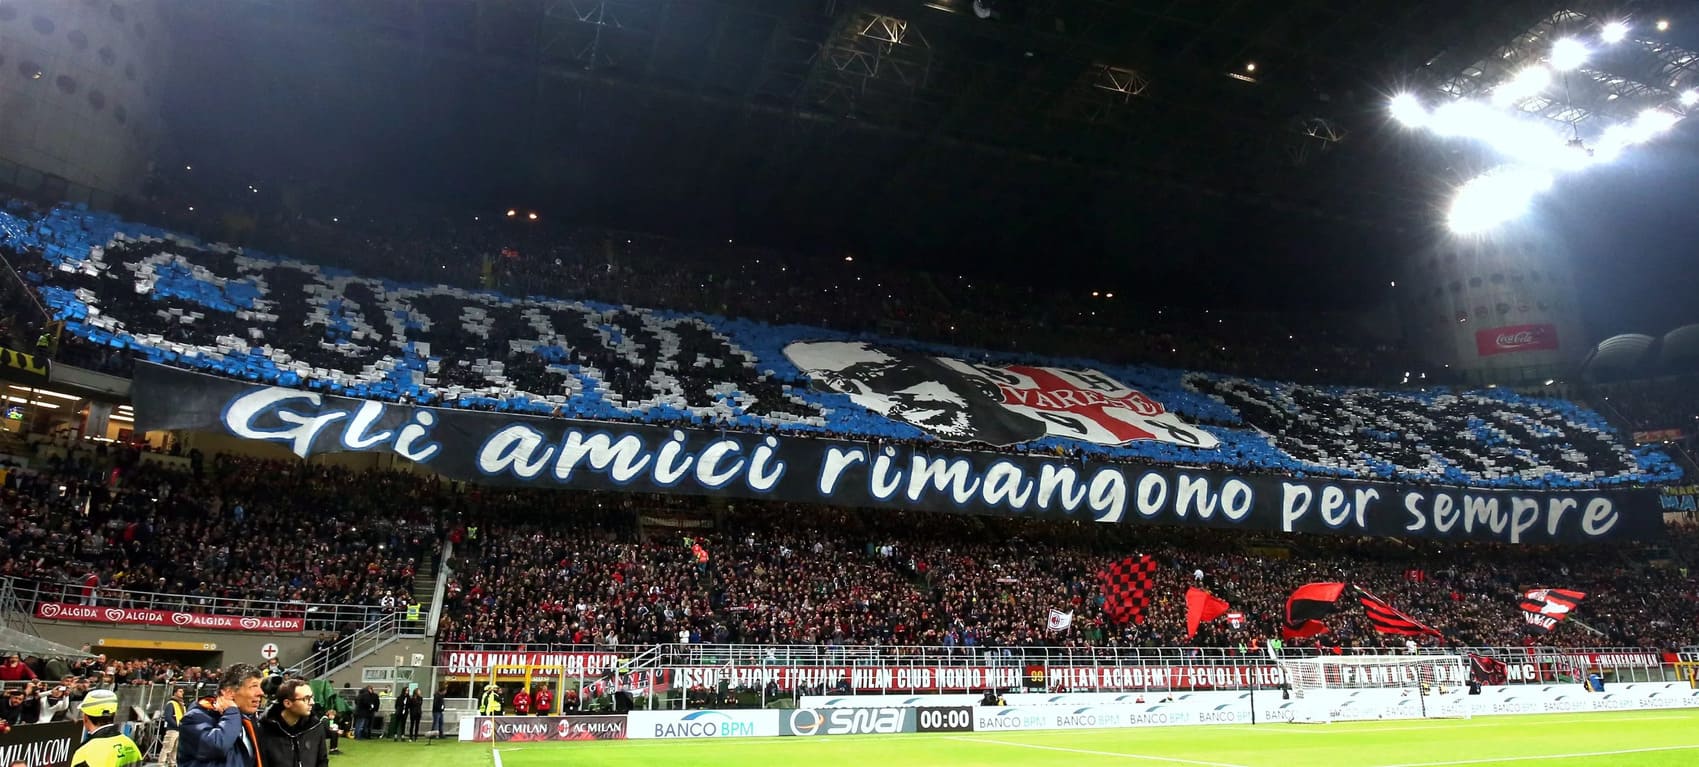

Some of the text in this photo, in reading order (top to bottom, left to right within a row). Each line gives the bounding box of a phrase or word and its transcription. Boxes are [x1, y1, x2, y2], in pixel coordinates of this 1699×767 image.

[224, 386, 1619, 544] Gli amici rimangono per sempre
[60, 607, 298, 629] ALGIDA ALGIDA ALGIDA ALGIDA
[449, 652, 483, 674] CASA
[487, 653, 527, 675] MILAN
[539, 654, 585, 675] JUNIOR
[851, 668, 893, 688] MILAN
[897, 668, 931, 688] CLUB
[935, 668, 980, 688] MONDO
[985, 668, 1022, 688] MILAN
[1031, 670, 1044, 682] 99
[1050, 667, 1097, 687] MILAN
[1103, 667, 1173, 687] ACADEMY
[1188, 667, 1242, 686] SCUOLA
[1342, 666, 1420, 683] FAMILY
[920, 710, 969, 729] 00:00
[979, 716, 1046, 729] BANCO BPM
[1056, 715, 1096, 727] BANCO
[1130, 713, 1167, 725] BANCO
[1199, 711, 1234, 722] BANCO
[655, 721, 754, 737] BANCO BPM
